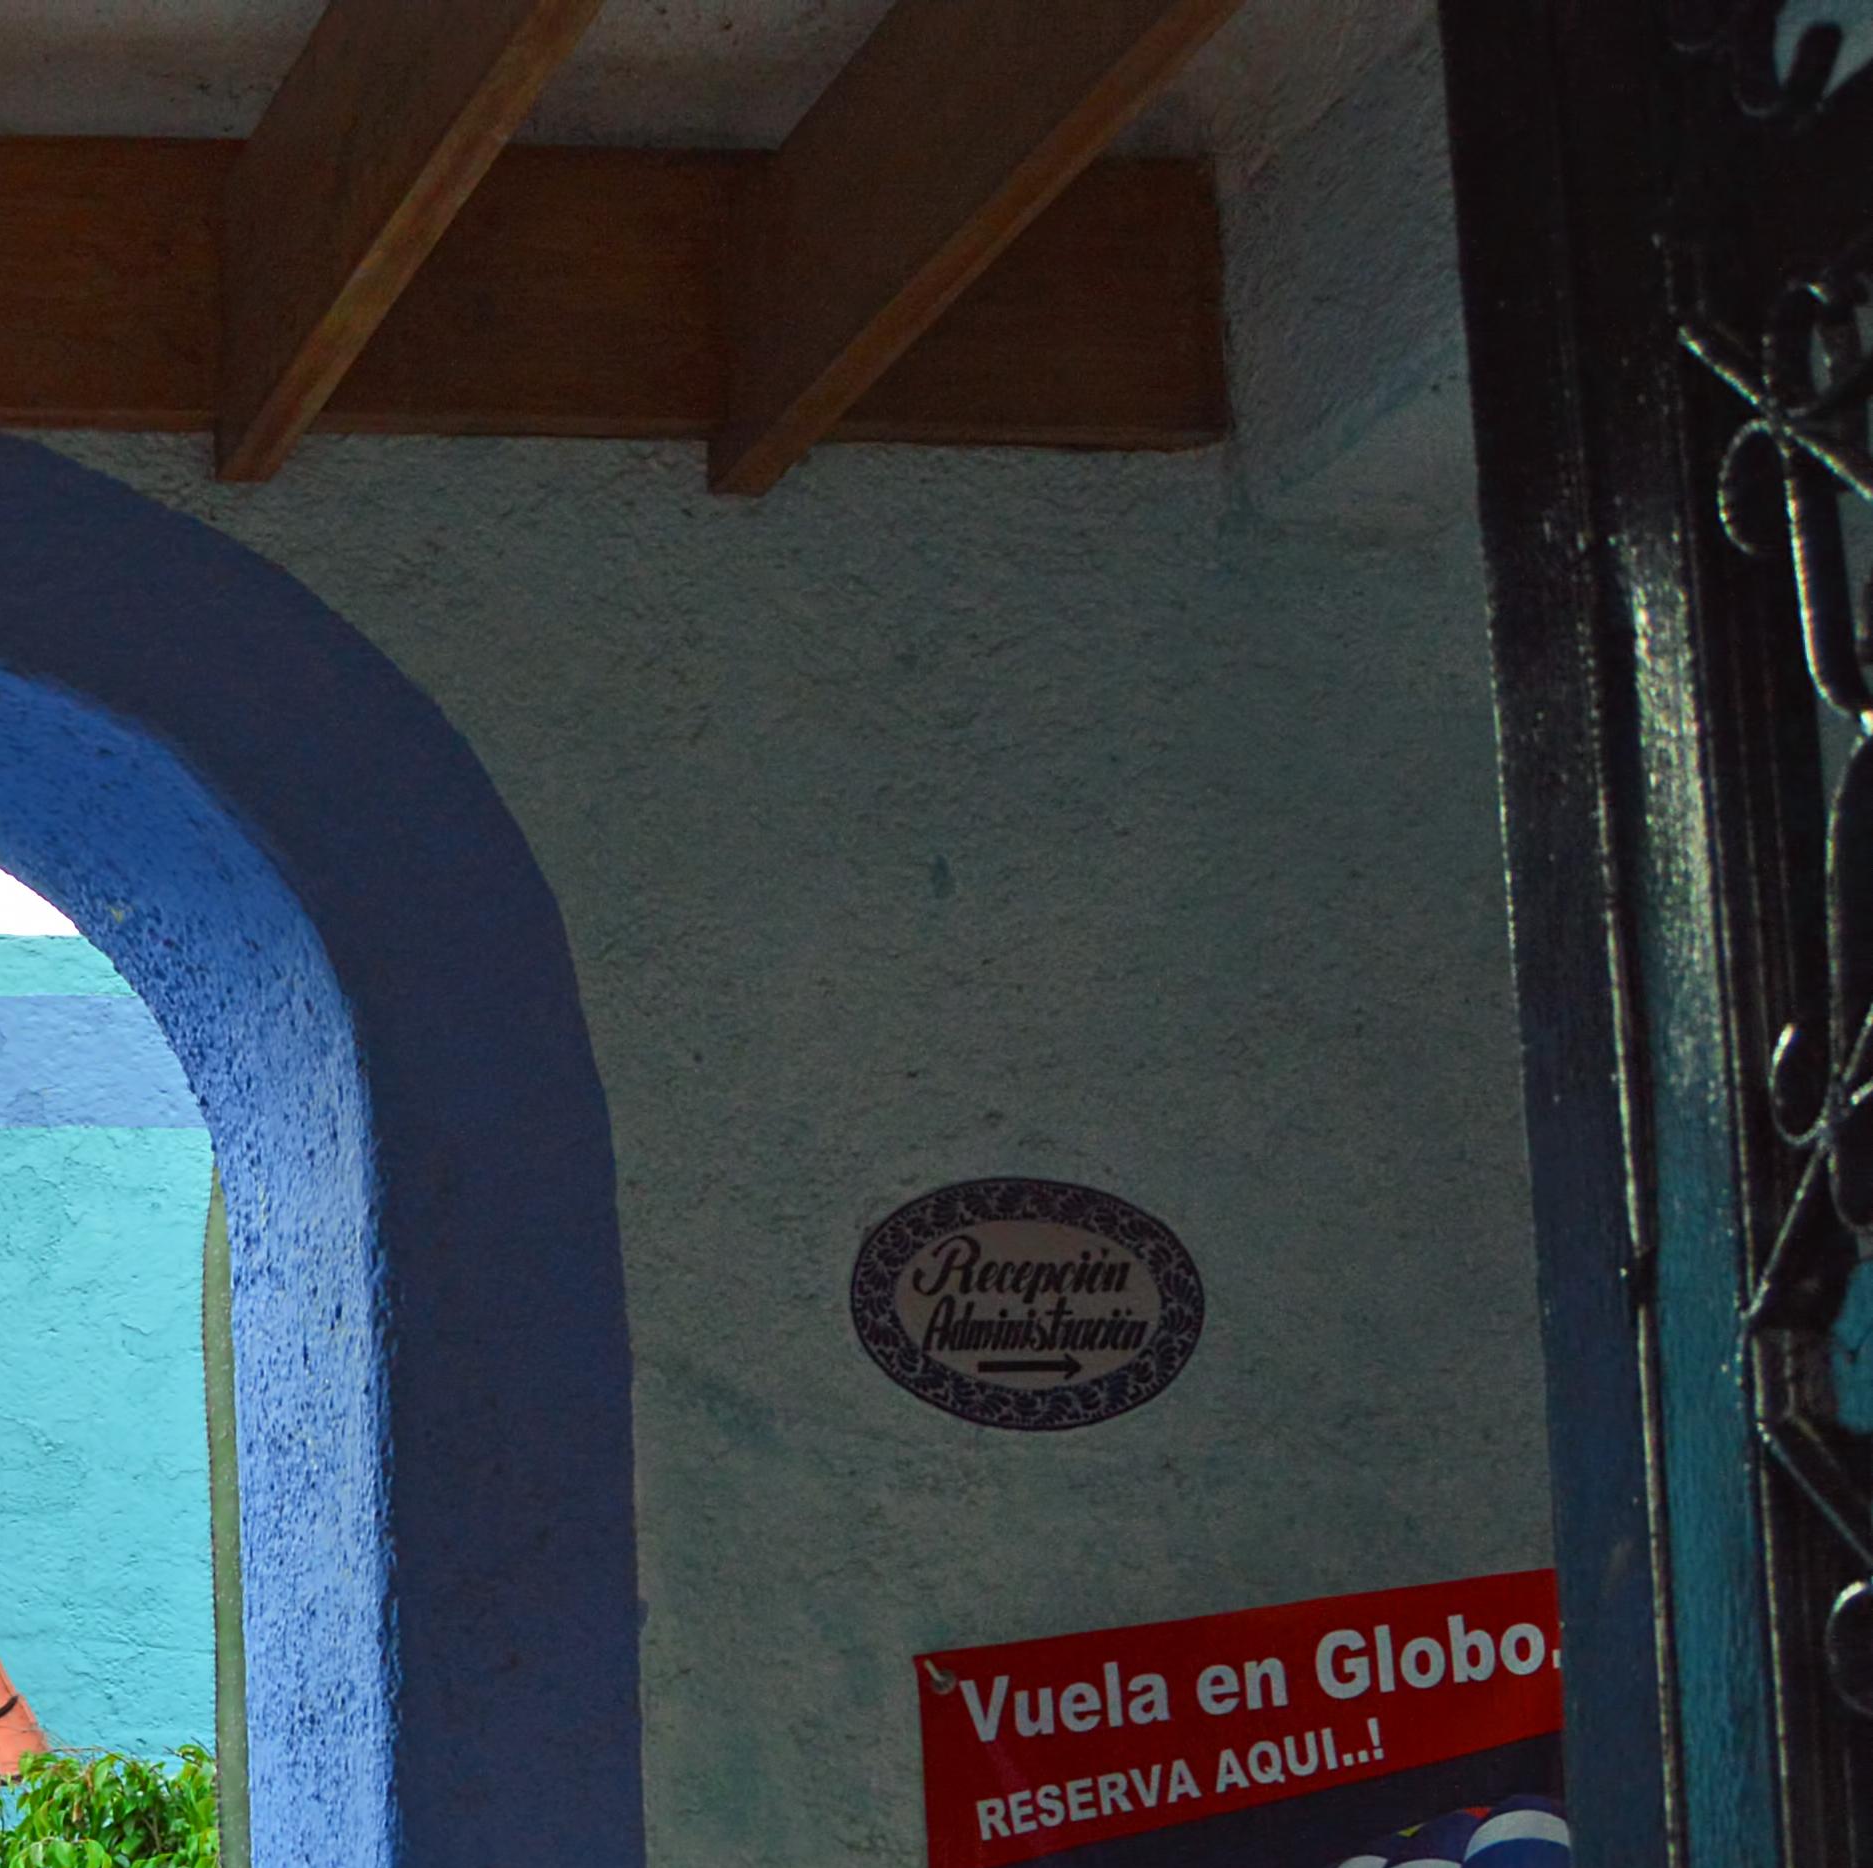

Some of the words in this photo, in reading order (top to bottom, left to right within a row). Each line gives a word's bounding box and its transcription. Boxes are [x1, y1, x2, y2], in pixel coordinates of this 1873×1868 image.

[911, 1235, 1132, 1304] Recepción
[959, 1661, 1170, 1743] Vuela
[1195, 1653, 1288, 1717] en
[975, 1758, 1201, 1841] RESERVA
